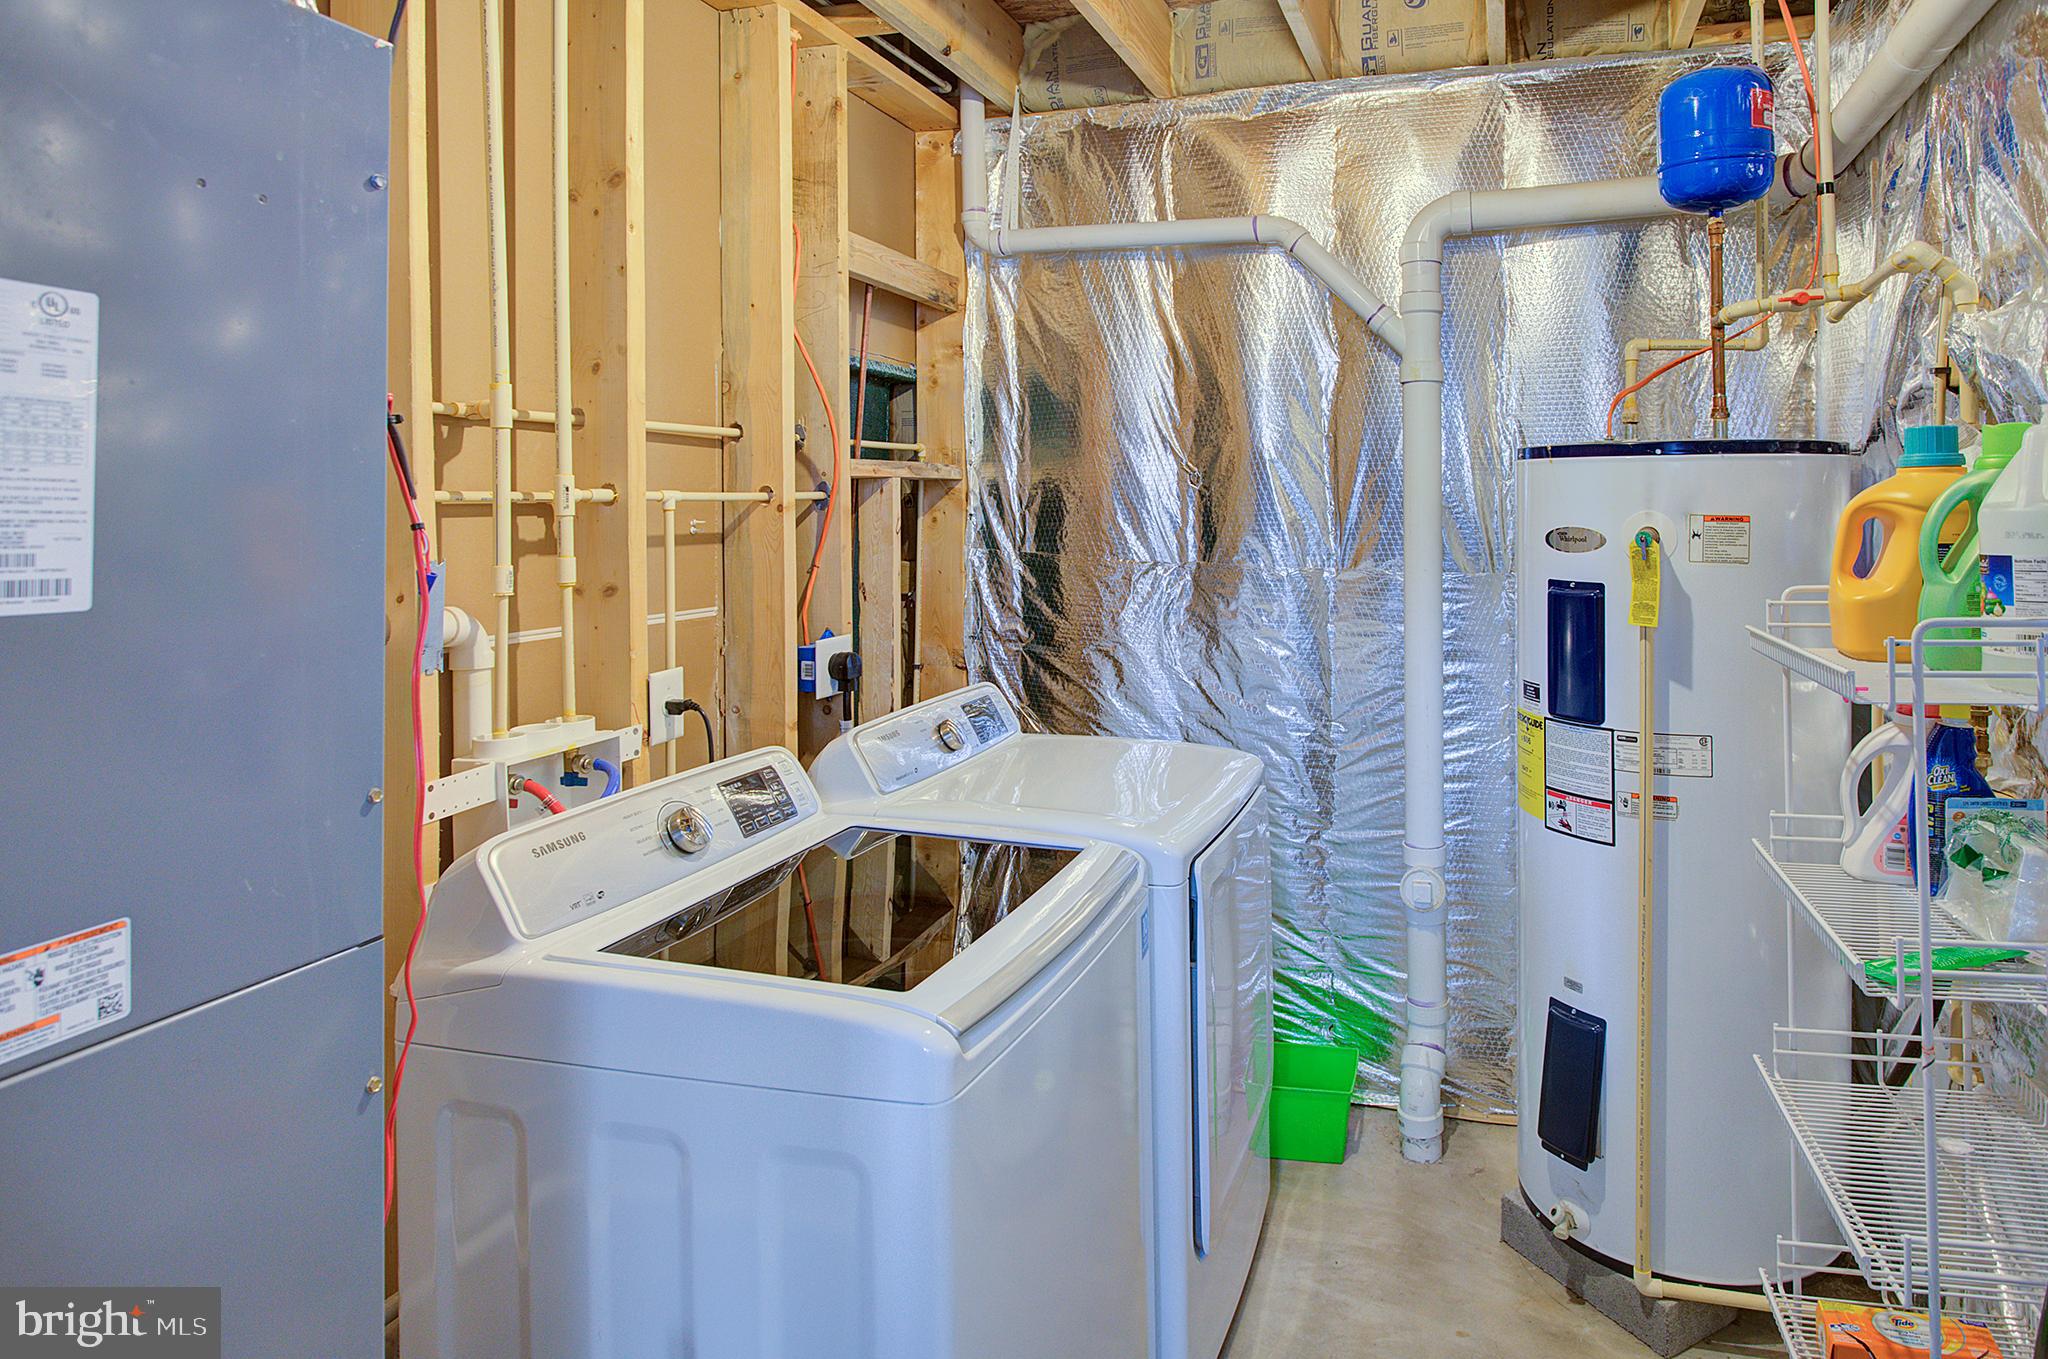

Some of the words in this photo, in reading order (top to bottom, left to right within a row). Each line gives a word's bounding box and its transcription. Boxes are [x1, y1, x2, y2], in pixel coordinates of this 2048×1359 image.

[1559, 535, 1587, 544] Whirlpool
[1927, 773, 1955, 786] CLEAN
[531, 831, 586, 858] SAMSUNG
[1891, 1317, 1915, 1328] Tide
